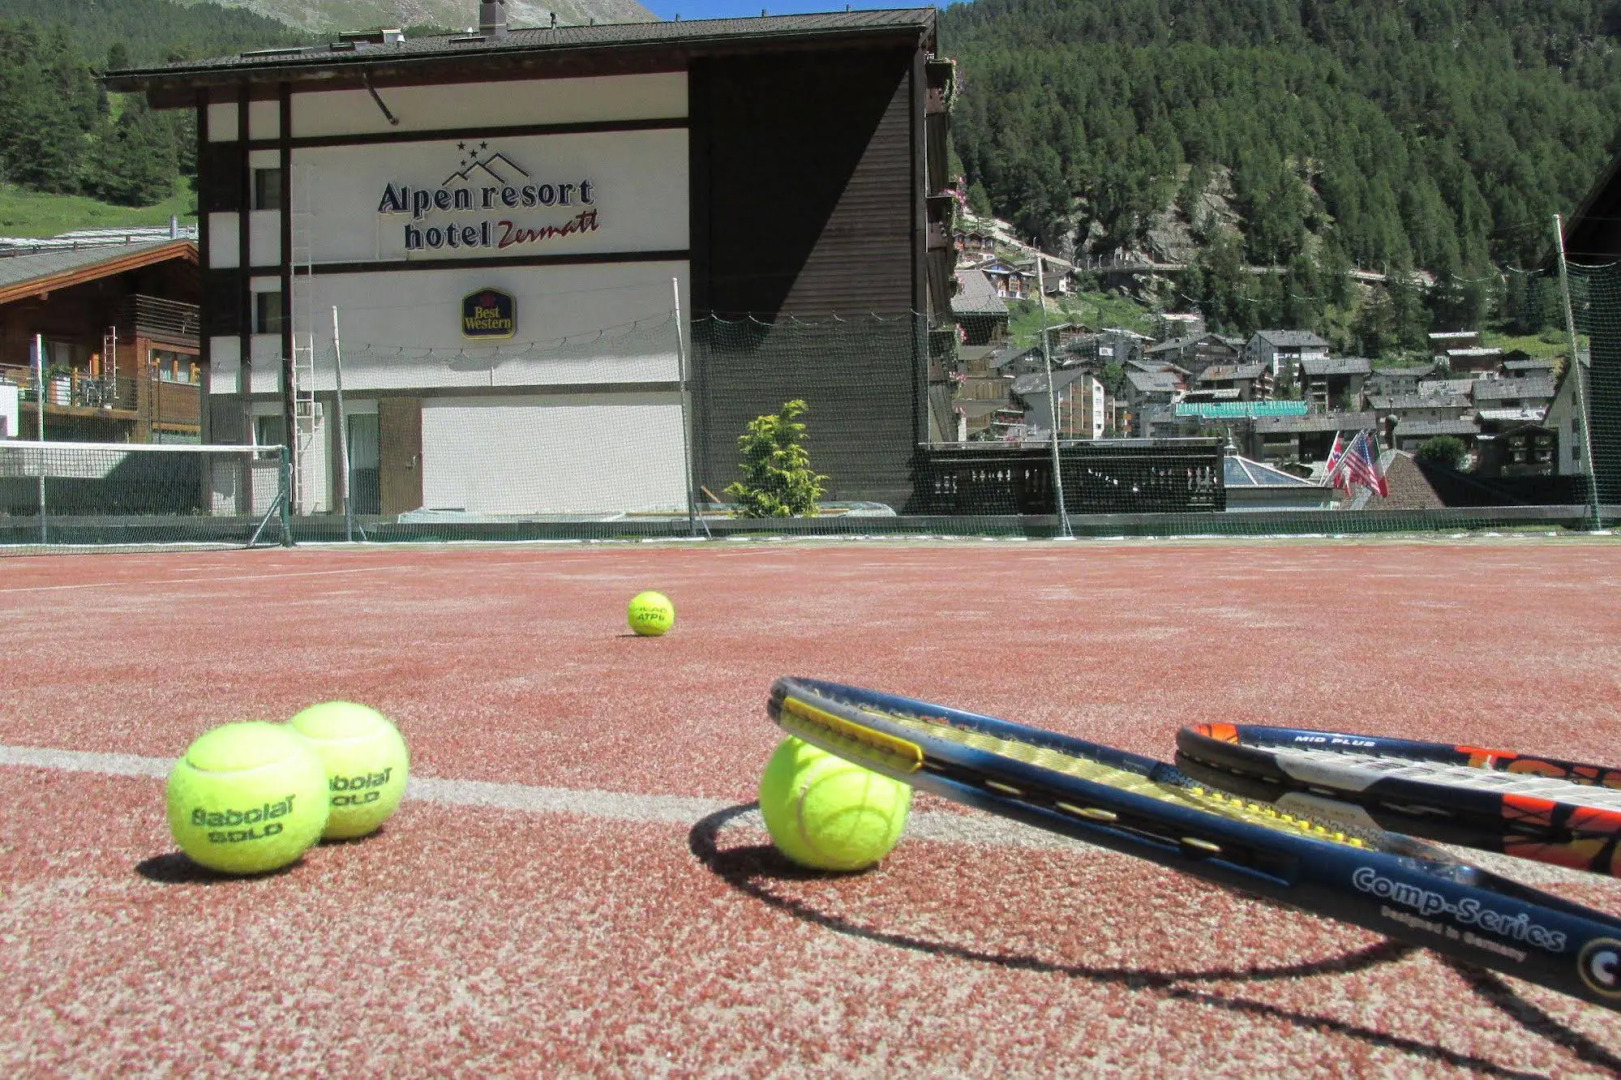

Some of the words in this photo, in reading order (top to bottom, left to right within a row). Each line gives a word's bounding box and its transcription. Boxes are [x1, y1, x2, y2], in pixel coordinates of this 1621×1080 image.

[378, 182, 475, 220] Alpen
[481, 178, 596, 207] resort
[404, 219, 493, 250] hotel
[498, 208, 599, 249] Zermatt
[474, 305, 500, 319] Best
[464, 317, 512, 330] Western
[1331, 738, 1376, 747] PLUS
[331, 791, 380, 806] OLD
[1353, 866, 1567, 951] Comp-Series
